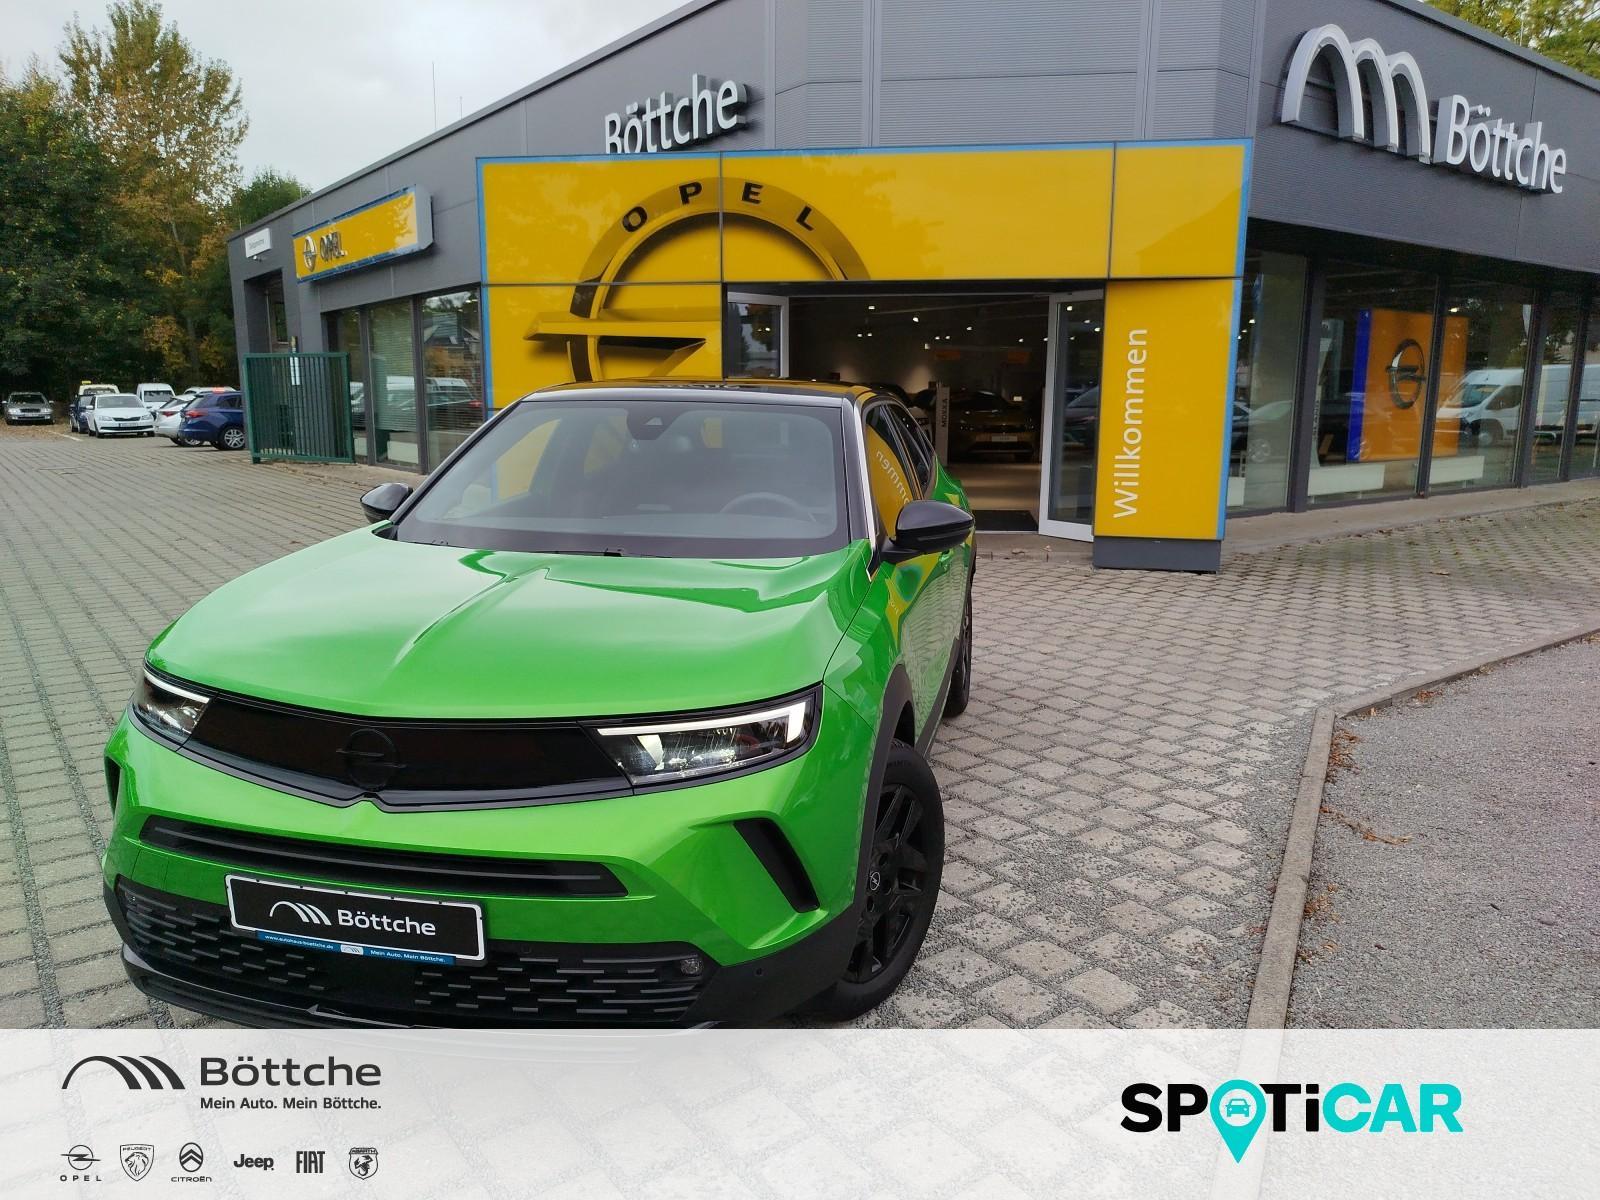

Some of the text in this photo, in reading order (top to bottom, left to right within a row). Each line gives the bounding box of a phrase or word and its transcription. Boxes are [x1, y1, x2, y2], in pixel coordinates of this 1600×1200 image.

[604, 73, 741, 154] Böttche
[1440, 94, 1567, 194] Böttche
[622, 181, 815, 233] OPEL
[1112, 328, 1149, 519] Willkommen
[337, 908, 437, 936] Böttche
